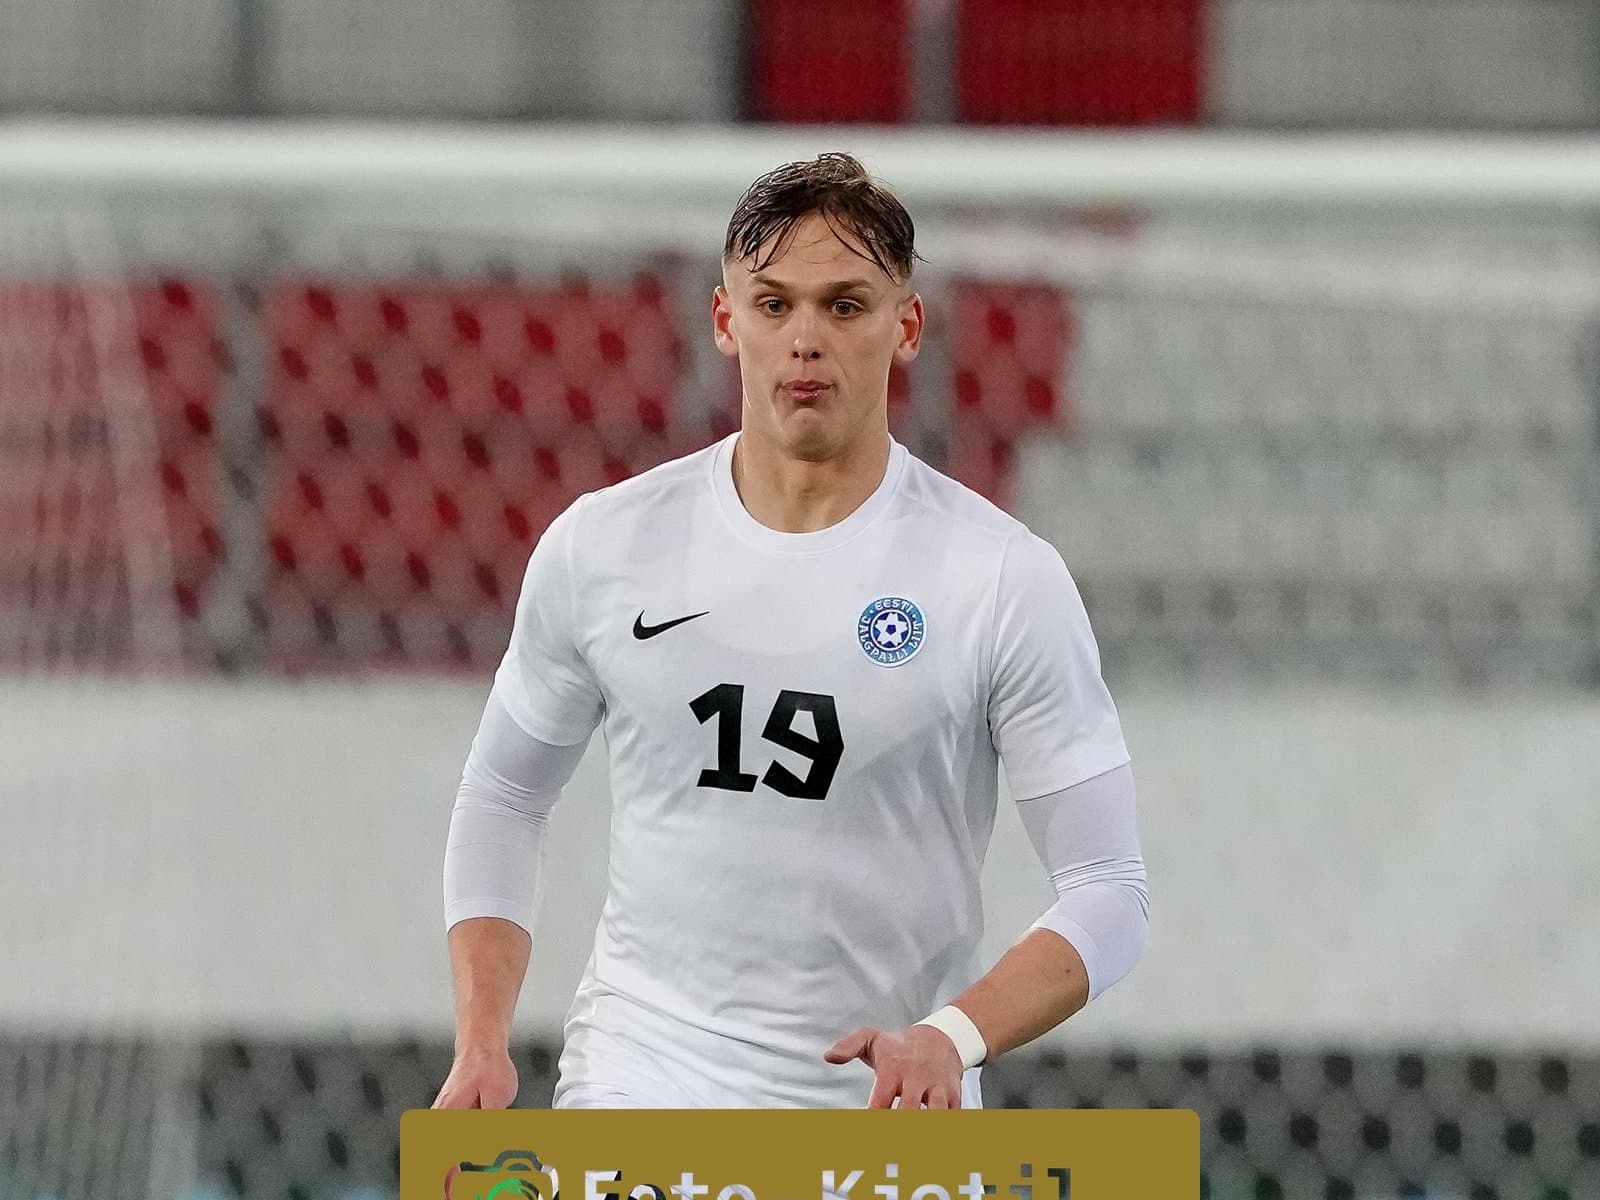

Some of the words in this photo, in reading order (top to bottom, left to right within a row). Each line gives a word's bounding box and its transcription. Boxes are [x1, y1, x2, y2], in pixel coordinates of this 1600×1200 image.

[874, 599, 913, 613] EESTI
[859, 616, 908, 662] JALGPALLI
[689, 683, 844, 800] 19
